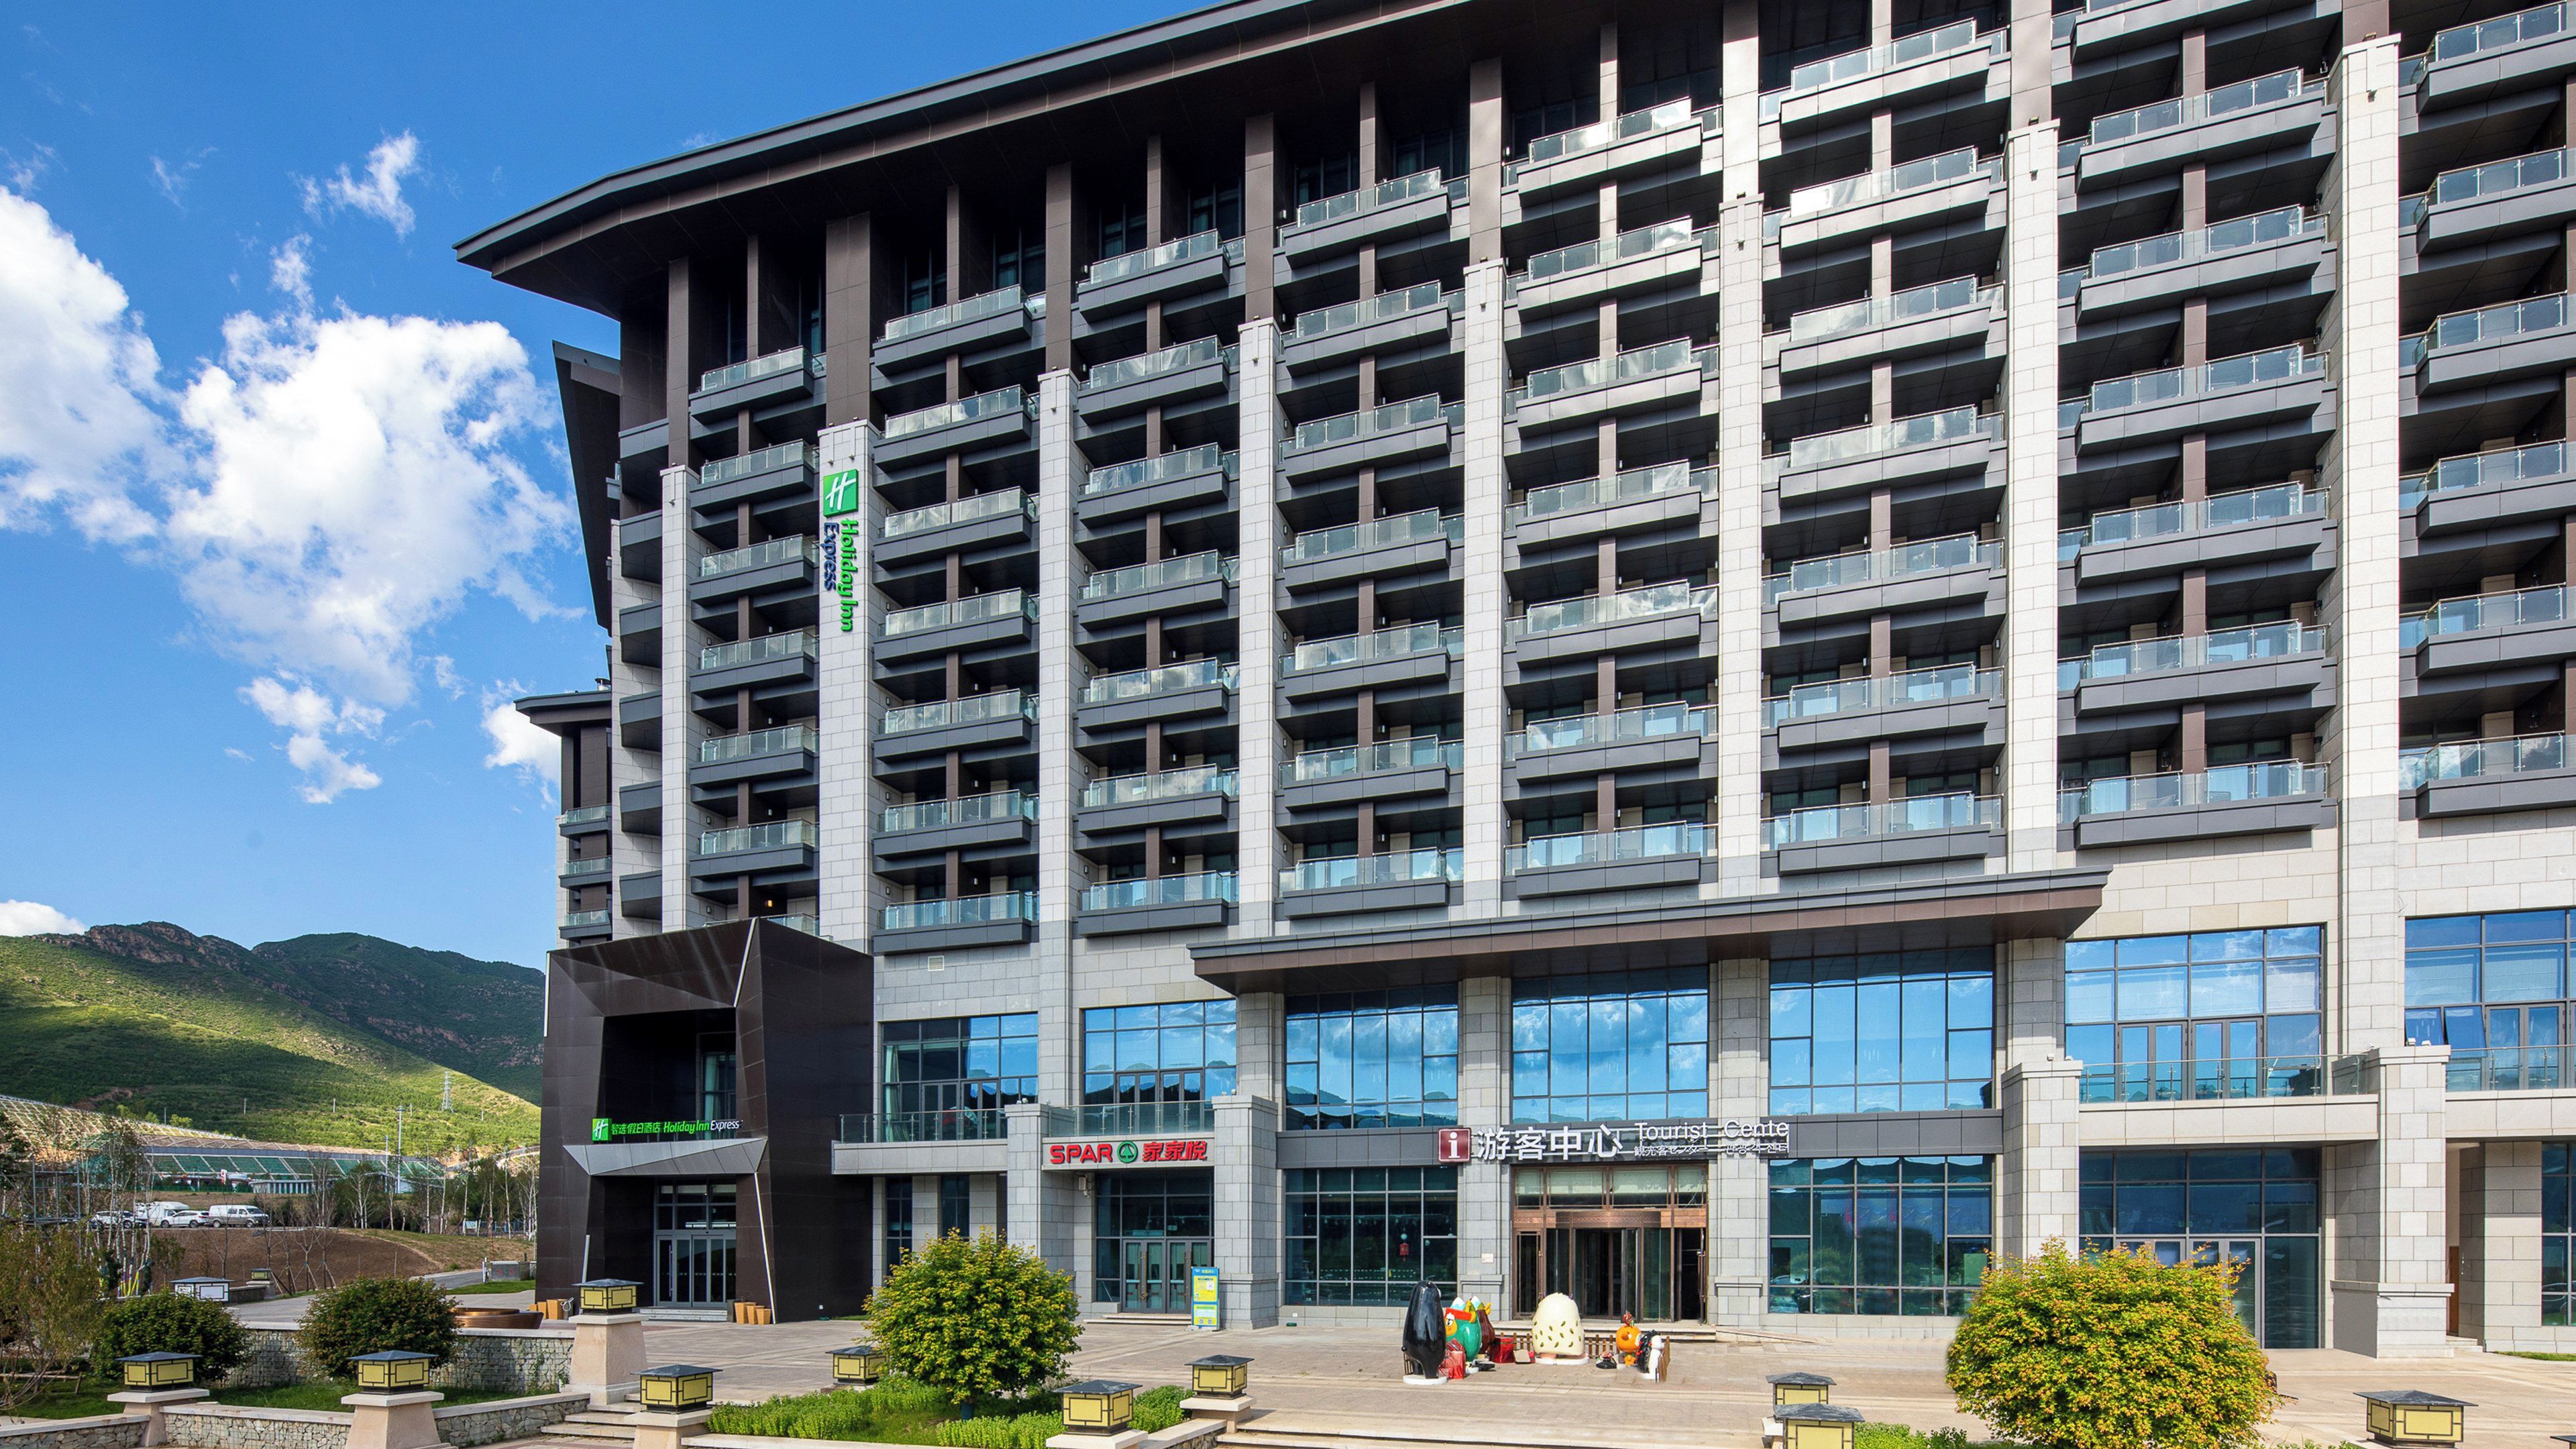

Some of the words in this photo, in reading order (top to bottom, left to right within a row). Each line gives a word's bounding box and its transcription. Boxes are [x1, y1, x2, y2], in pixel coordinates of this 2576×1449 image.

[820, 522, 839, 591] Express
[837, 518, 858, 596] Holiday
[841, 600, 858, 631] Inn
[611, 1122, 661, 1135] 智选假日酒店
[663, 1121, 695, 1134] Holiday
[696, 1120, 710, 1131] Inn
[710, 1120, 740, 1132] Express
[1635, 1122, 1708, 1140] Tourist
[1724, 1120, 1789, 1138] Cente
[1050, 1143, 1112, 1164] SPAR
[1142, 1140, 1208, 1162] 家家悦
[1477, 1124, 1623, 1161] 游客中心
